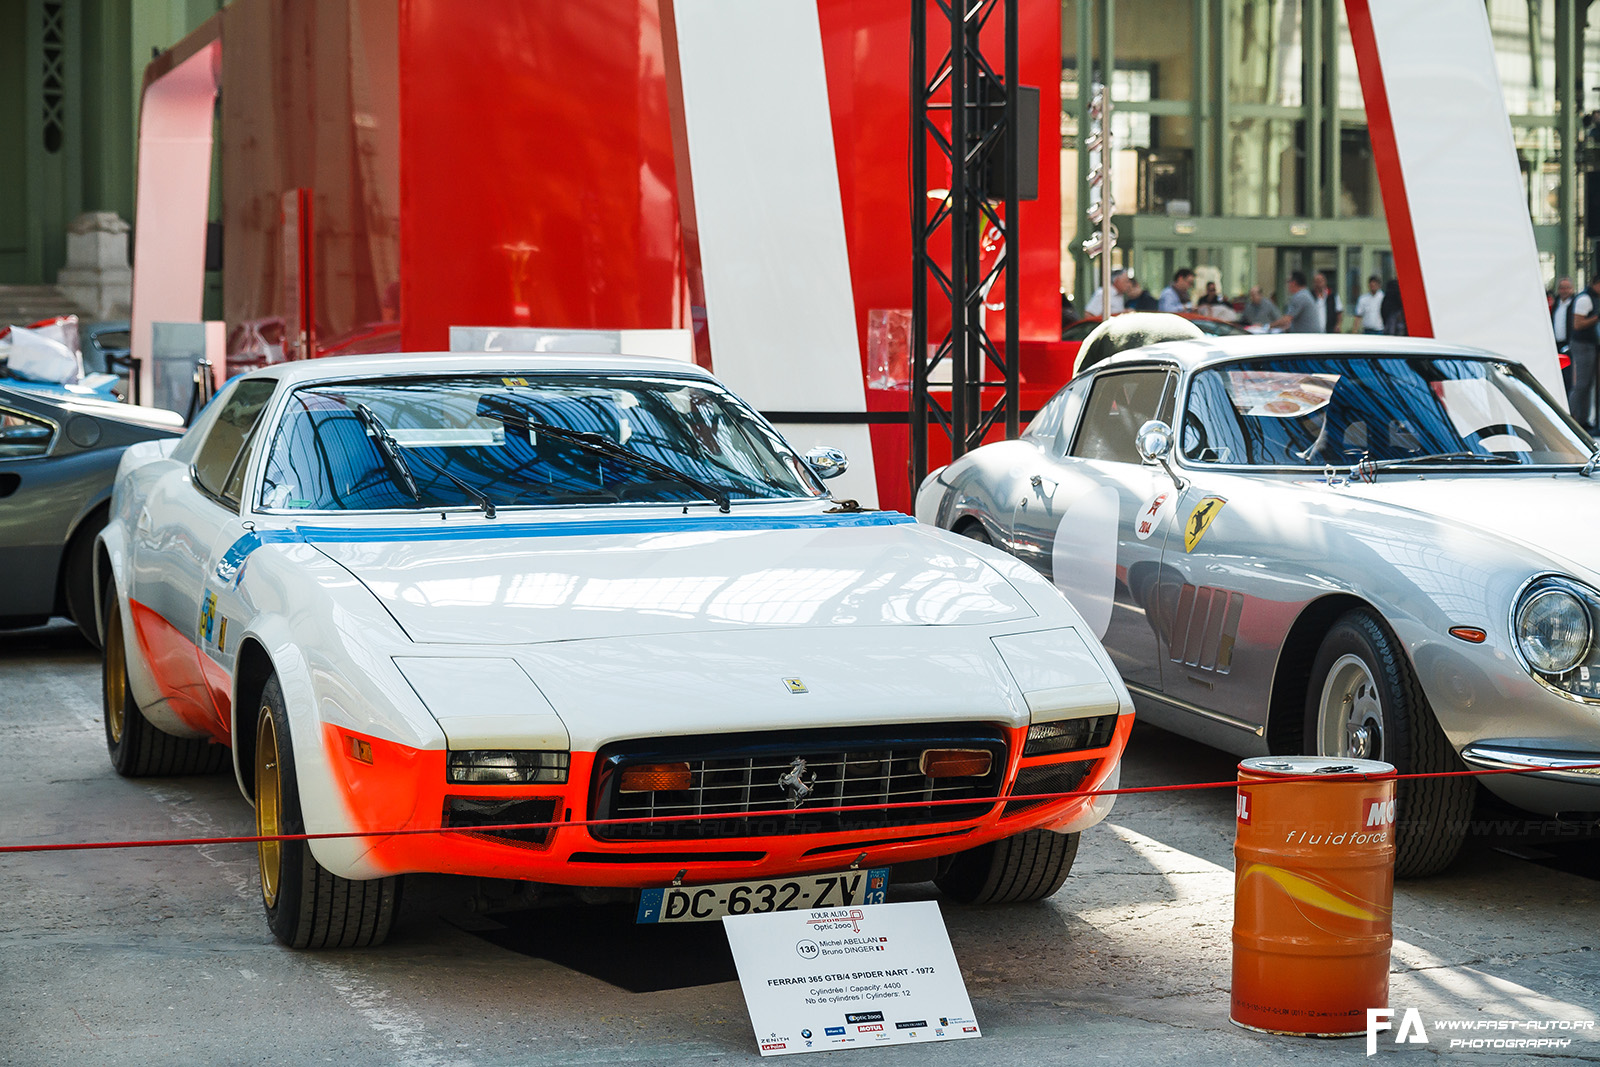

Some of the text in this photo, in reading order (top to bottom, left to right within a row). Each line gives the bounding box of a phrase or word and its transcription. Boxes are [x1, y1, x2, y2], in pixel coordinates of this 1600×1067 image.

[1138, 520, 1152, 535] 2014
[1366, 798, 1398, 827] MO
[644, 909, 653, 918] F
[830, 910, 848, 918] AUTO
[813, 922, 833, 931] Optic
[819, 936, 879, 947] Michel ABELLAN
[799, 945, 817, 954] 136
[821, 946, 876, 956] Bruno DINGER
[767, 977, 807, 987] FERRARI
[808, 975, 824, 984] 365
[824, 973, 851, 982] GTB/4
[851, 970, 884, 980] SPIDER
[884, 968, 910, 977] NART
[915, 966, 936, 975] 1972
[809, 986, 844, 996] Cylindrée
[849, 983, 882, 993] Capacity:
[805, 997, 817, 1005] Nb
[817, 996, 828, 1004] de
[828, 994, 860, 1003] cylindres
[865, 991, 901, 1001] Cylinders:
[902, 989, 911, 997] 12
[859, 1024, 883, 1032] MOTUL
[760, 1036, 790, 1044] ZENITH
